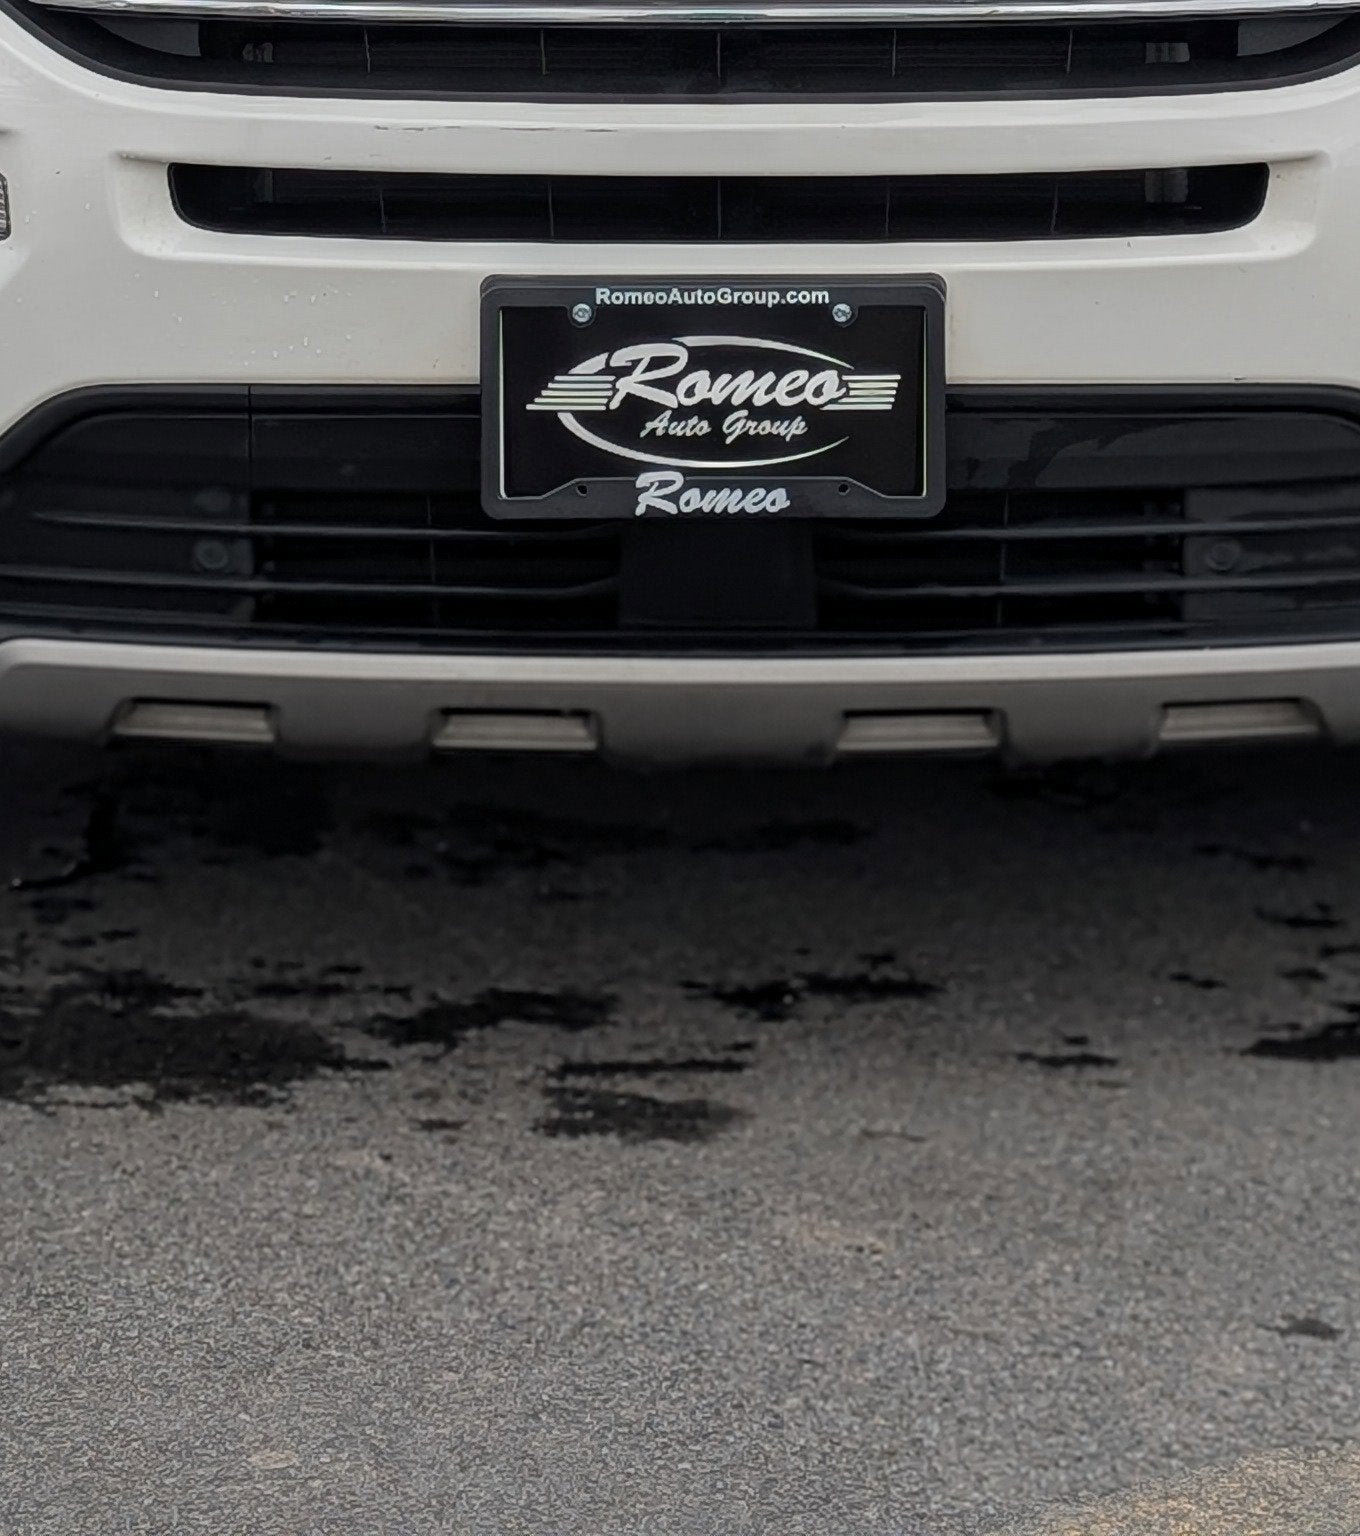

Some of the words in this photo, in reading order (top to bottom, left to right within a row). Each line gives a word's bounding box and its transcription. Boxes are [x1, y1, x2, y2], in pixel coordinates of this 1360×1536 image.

[595, 287, 830, 308] RomeoAutoGroup.com
[608, 342, 845, 409] Romeo
[640, 410, 712, 438] Auto
[721, 411, 809, 444] Group
[634, 470, 791, 516] Romeo
